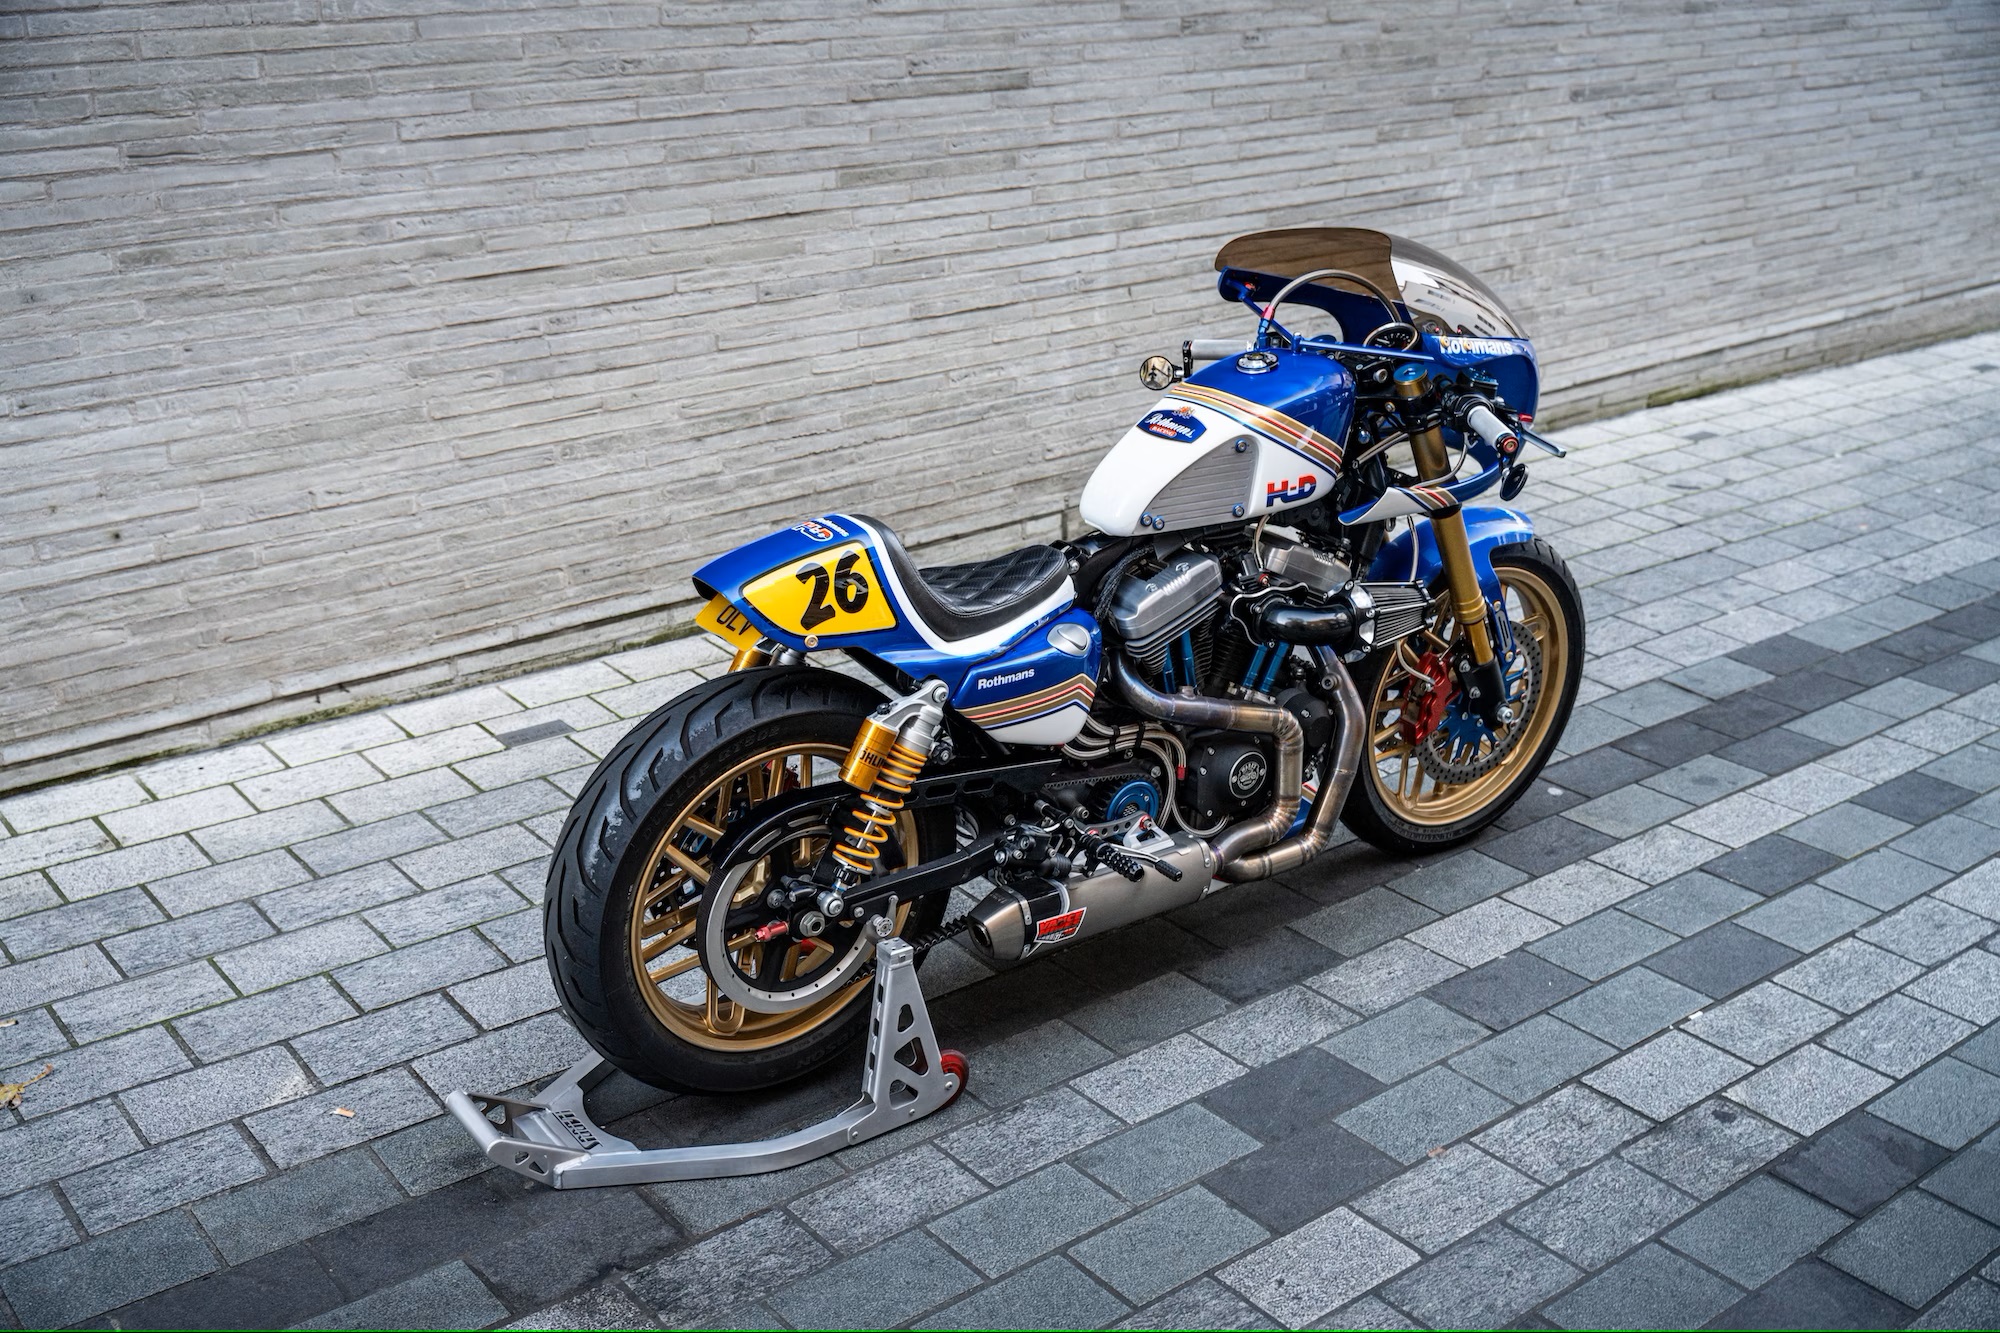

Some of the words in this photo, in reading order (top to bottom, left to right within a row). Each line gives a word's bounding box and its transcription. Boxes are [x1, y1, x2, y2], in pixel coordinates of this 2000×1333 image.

[1266, 475, 1317, 507] H-D
[795, 550, 869, 631] 26
[716, 604, 753, 635] OLV
[977, 668, 1035, 690] Rothmans
